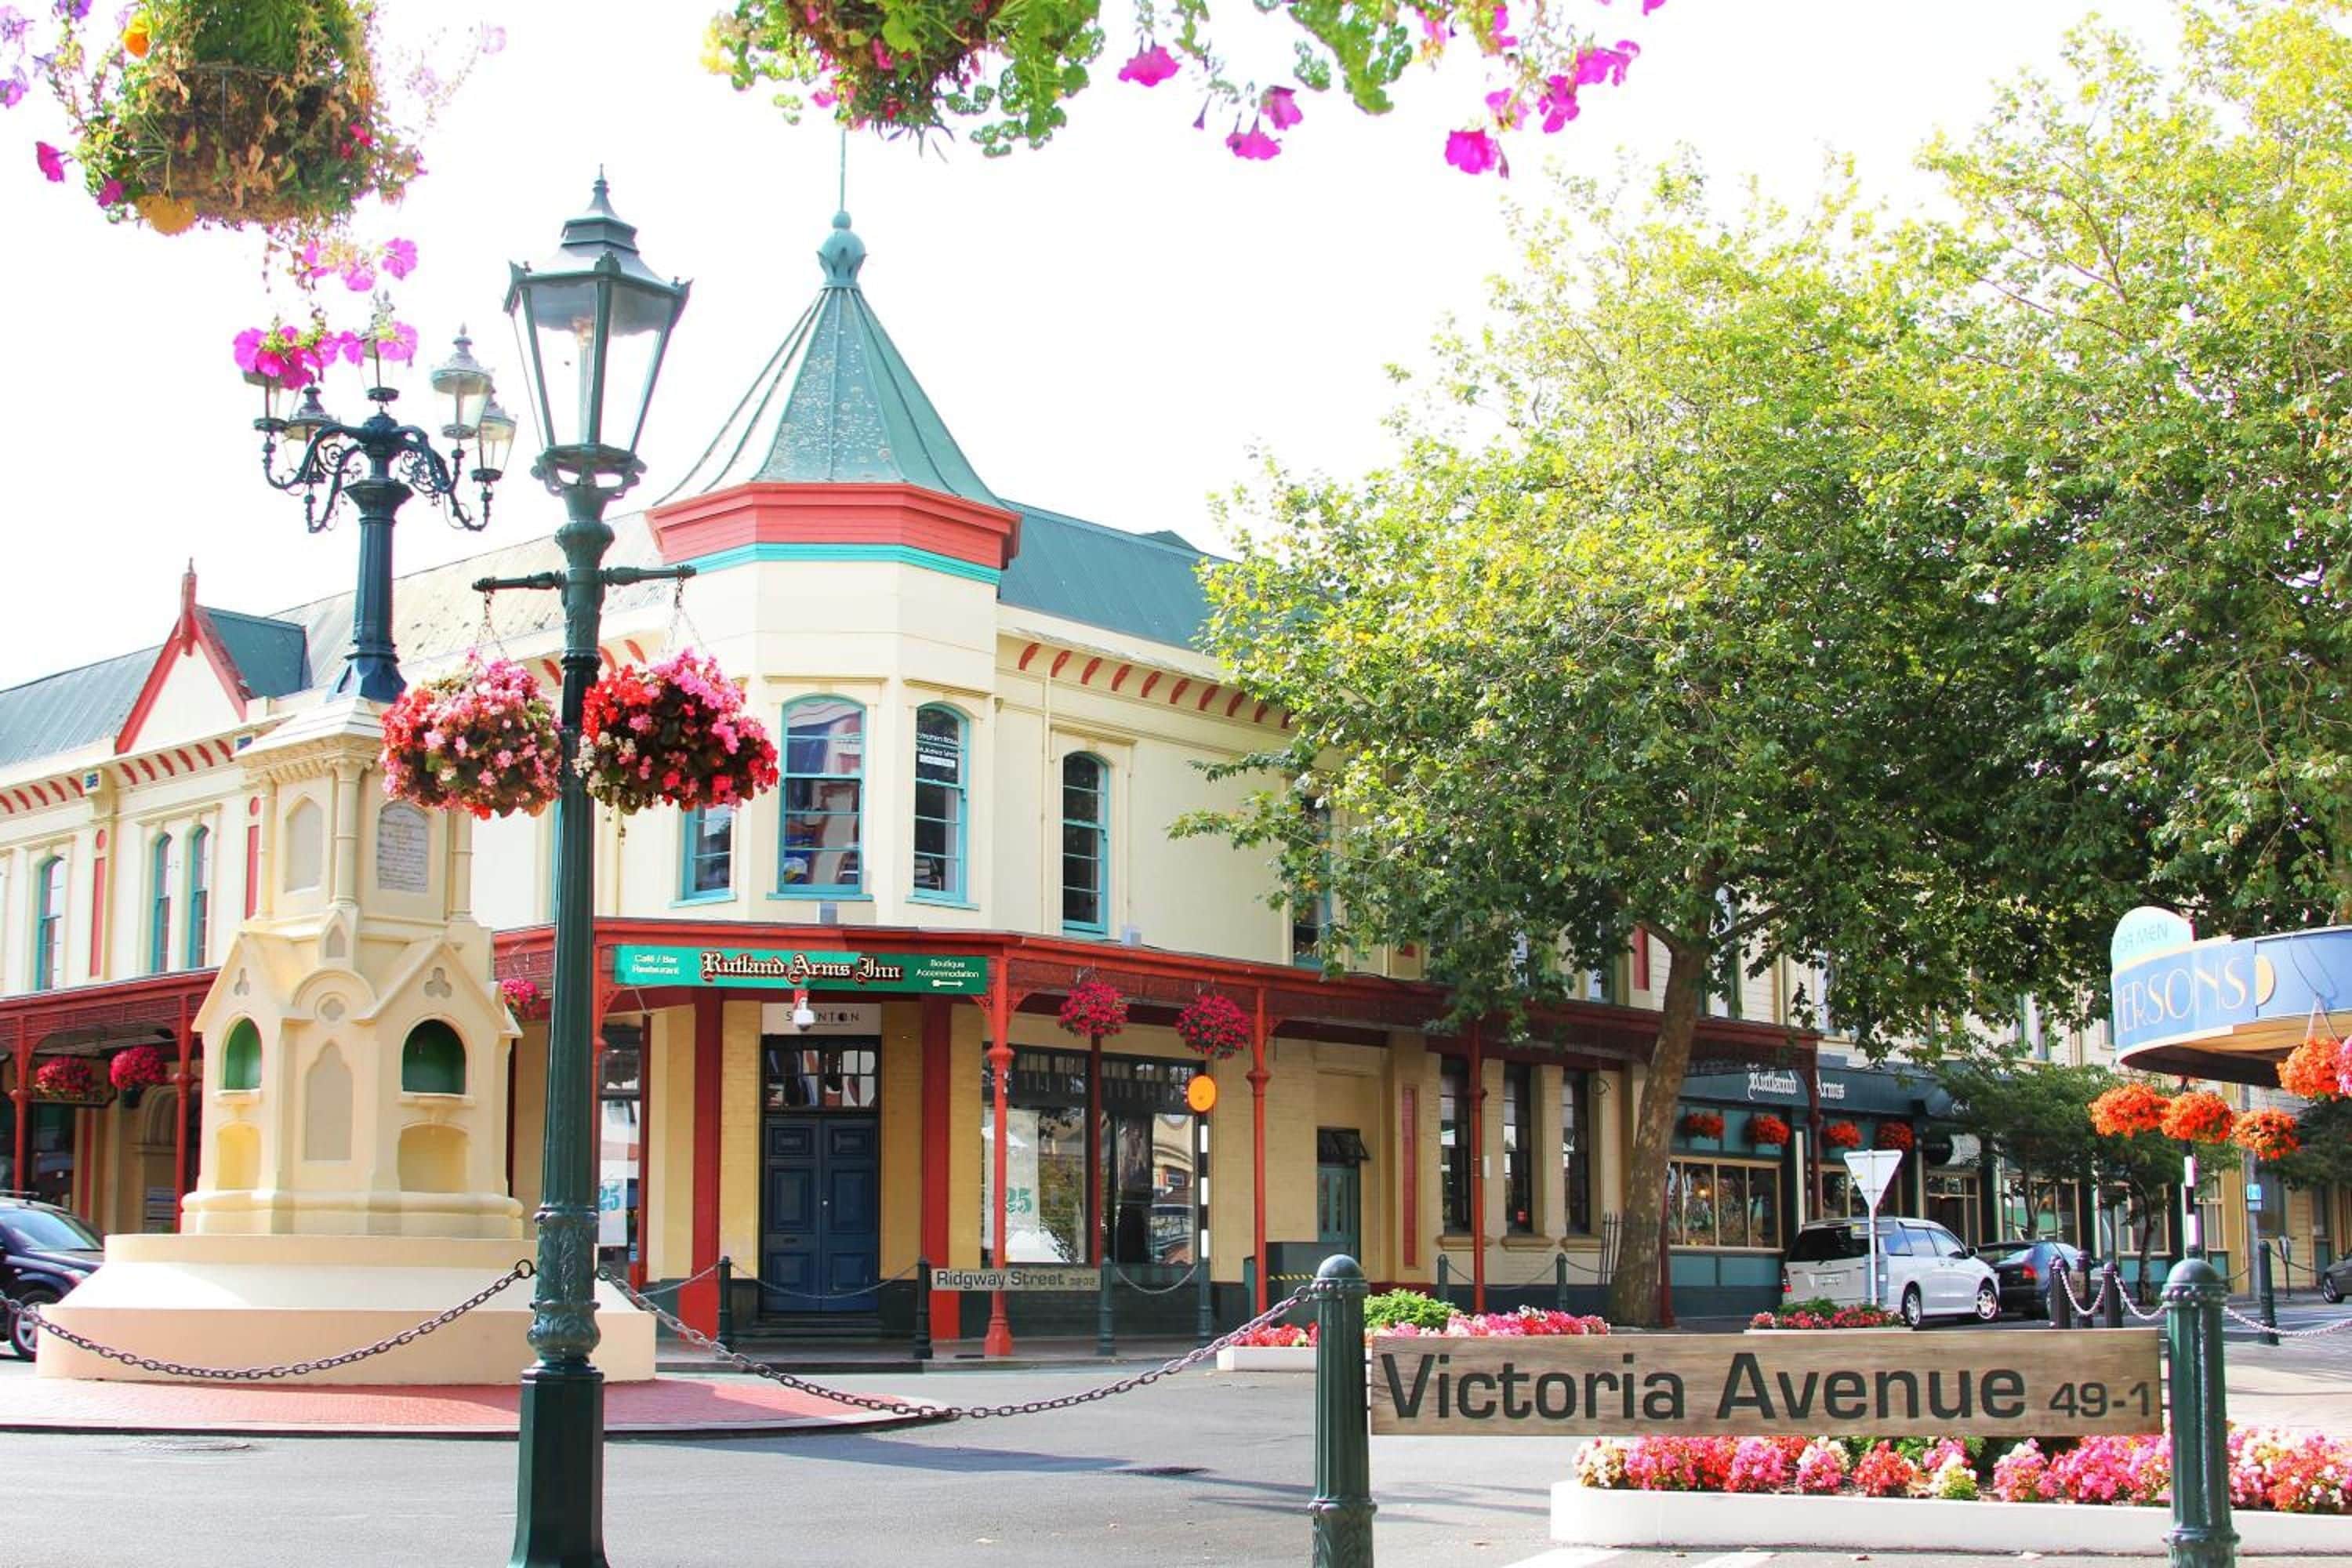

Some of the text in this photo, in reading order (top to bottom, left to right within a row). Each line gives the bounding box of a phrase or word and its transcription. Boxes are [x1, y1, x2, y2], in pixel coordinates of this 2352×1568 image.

[701, 951, 903, 985] Rutland Arms Inn
[930, 959, 965, 969] Boutique
[785, 1011, 860, 1023] SNTON
[1747, 1064, 1798, 1100] Rutland
[937, 1271, 1006, 1289] Ridgway
[1011, 1271, 1065, 1286] Street
[1381, 1352, 2150, 1420] Victoria Avenue 49-1
